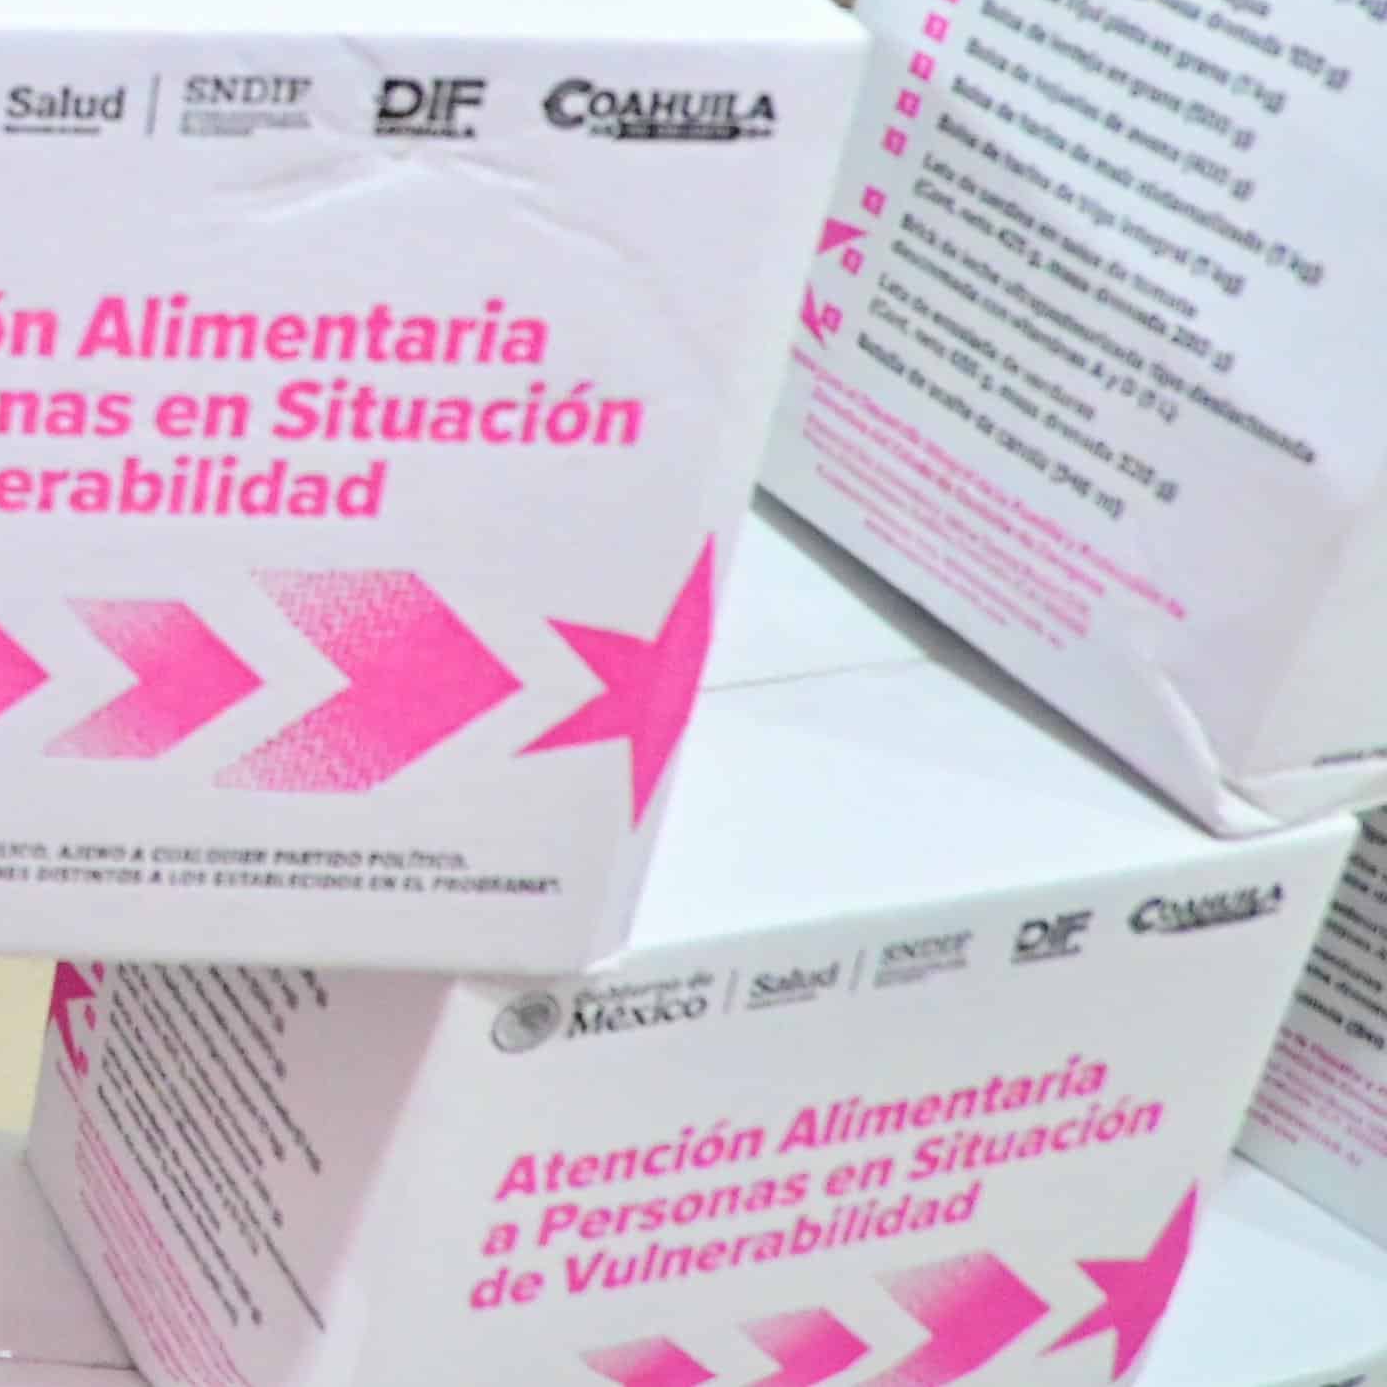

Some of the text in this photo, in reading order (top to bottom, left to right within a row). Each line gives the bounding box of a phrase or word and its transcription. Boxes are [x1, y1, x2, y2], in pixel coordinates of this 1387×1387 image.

[8, 86, 125, 122] Salud
[185, 75, 312, 105] SNDIF
[375, 78, 487, 121] DIF
[543, 79, 776, 130] COAHUILA
[76, 293, 550, 366] Alimentaria
[155, 394, 251, 438] en
[271, 378, 644, 446] Situación
[1013, 910, 1093, 954] DIF
[496, 1057, 1107, 1202] Atención Alimentaria
[484, 1104, 1163, 1255] a Personas en Situación
[470, 1183, 981, 1309] de Vulnerabilidad
